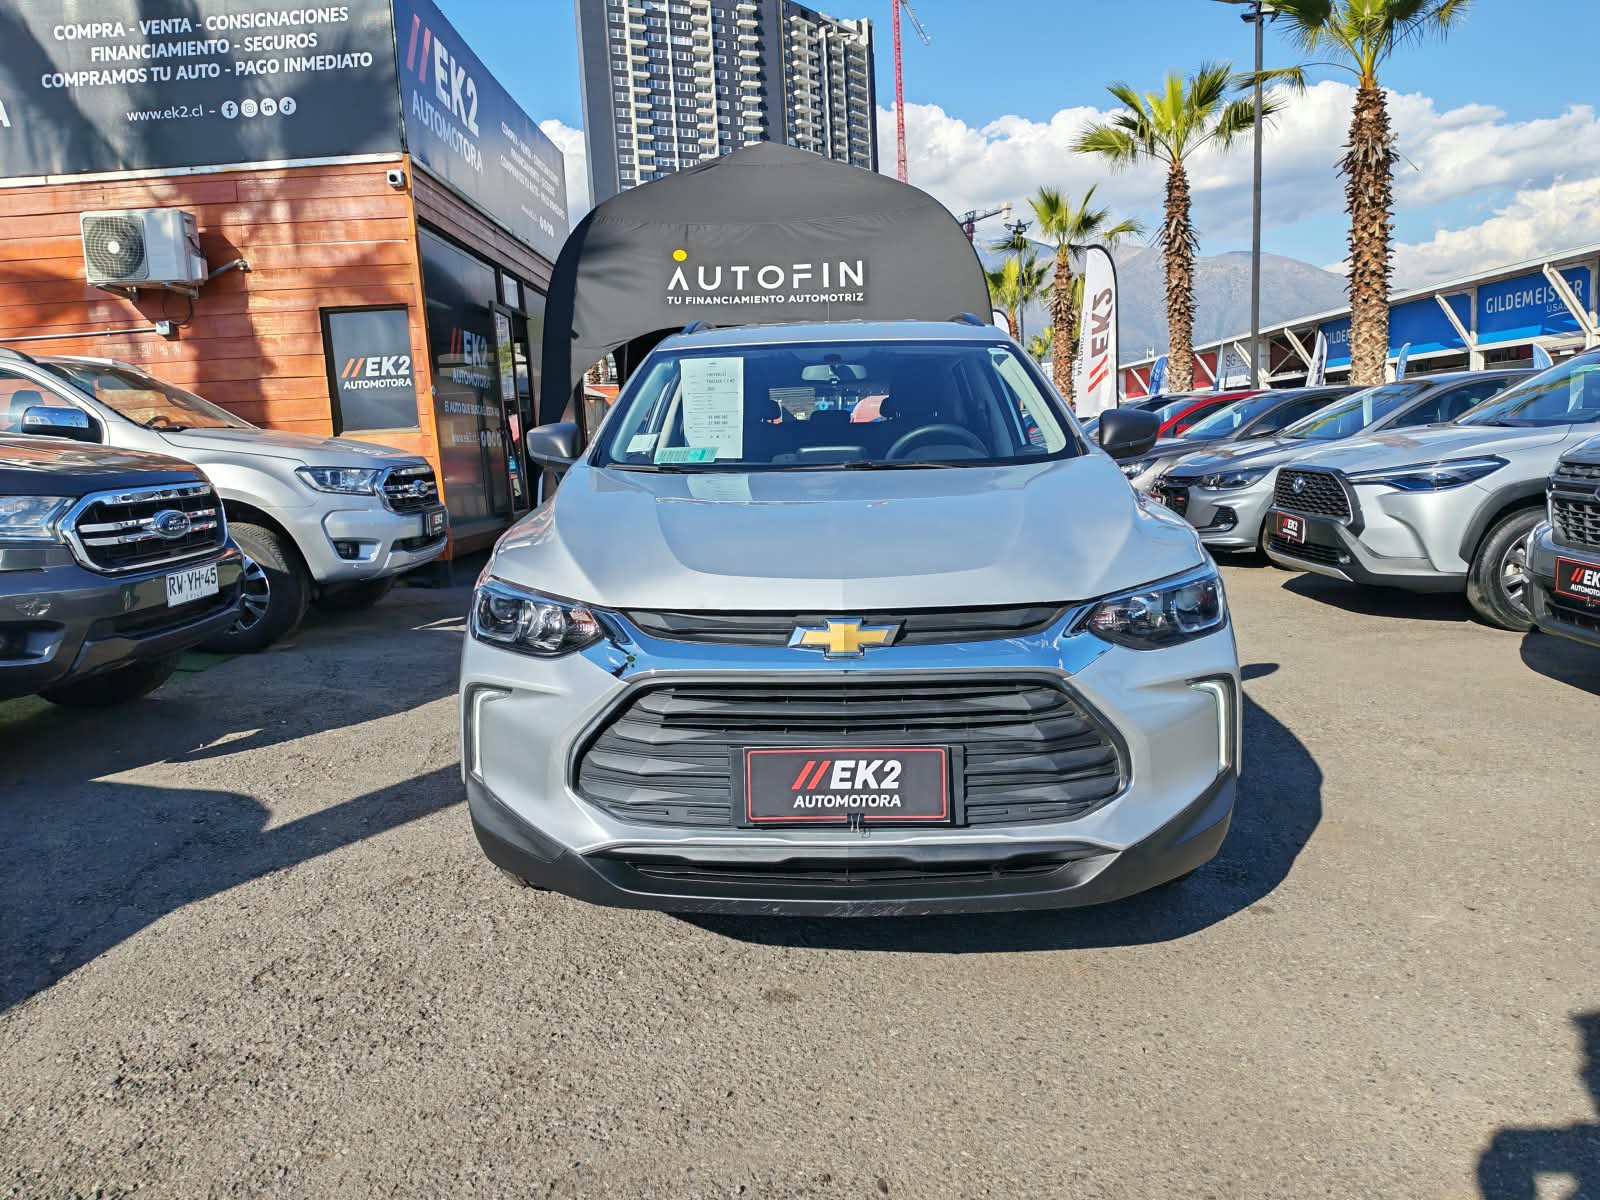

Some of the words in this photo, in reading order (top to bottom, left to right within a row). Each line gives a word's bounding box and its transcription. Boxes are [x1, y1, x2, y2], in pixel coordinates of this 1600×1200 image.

[53, 23, 125, 41] COMPRA
[139, 17, 192, 36] VENTA
[205, 6, 349, 31] CONSIGNACIONES
[90, 38, 230, 63] FINANCIAMIENTO
[244, 32, 318, 52] SEGUROS
[41, 68, 147, 89] COMPRAMOS
[151, 66, 172, 83] TU
[175, 63, 220, 81] AUTO
[235, 60, 280, 77] PAGO
[283, 52, 373, 73] INMEDIATO
[126, 105, 204, 122] www.ek2.cl
[412, 88, 484, 177] AUTOMOTORA
[667, 260, 864, 291] AUTOFIN
[667, 296, 682, 305] TU
[685, 294, 785, 305] FINANCIAMIENTO
[788, 292, 864, 303] AUTOMOTRIZ
[343, 378, 412, 390] AUTOMOTORA
[793, 794, 902, 809] AUTOMOTORA
